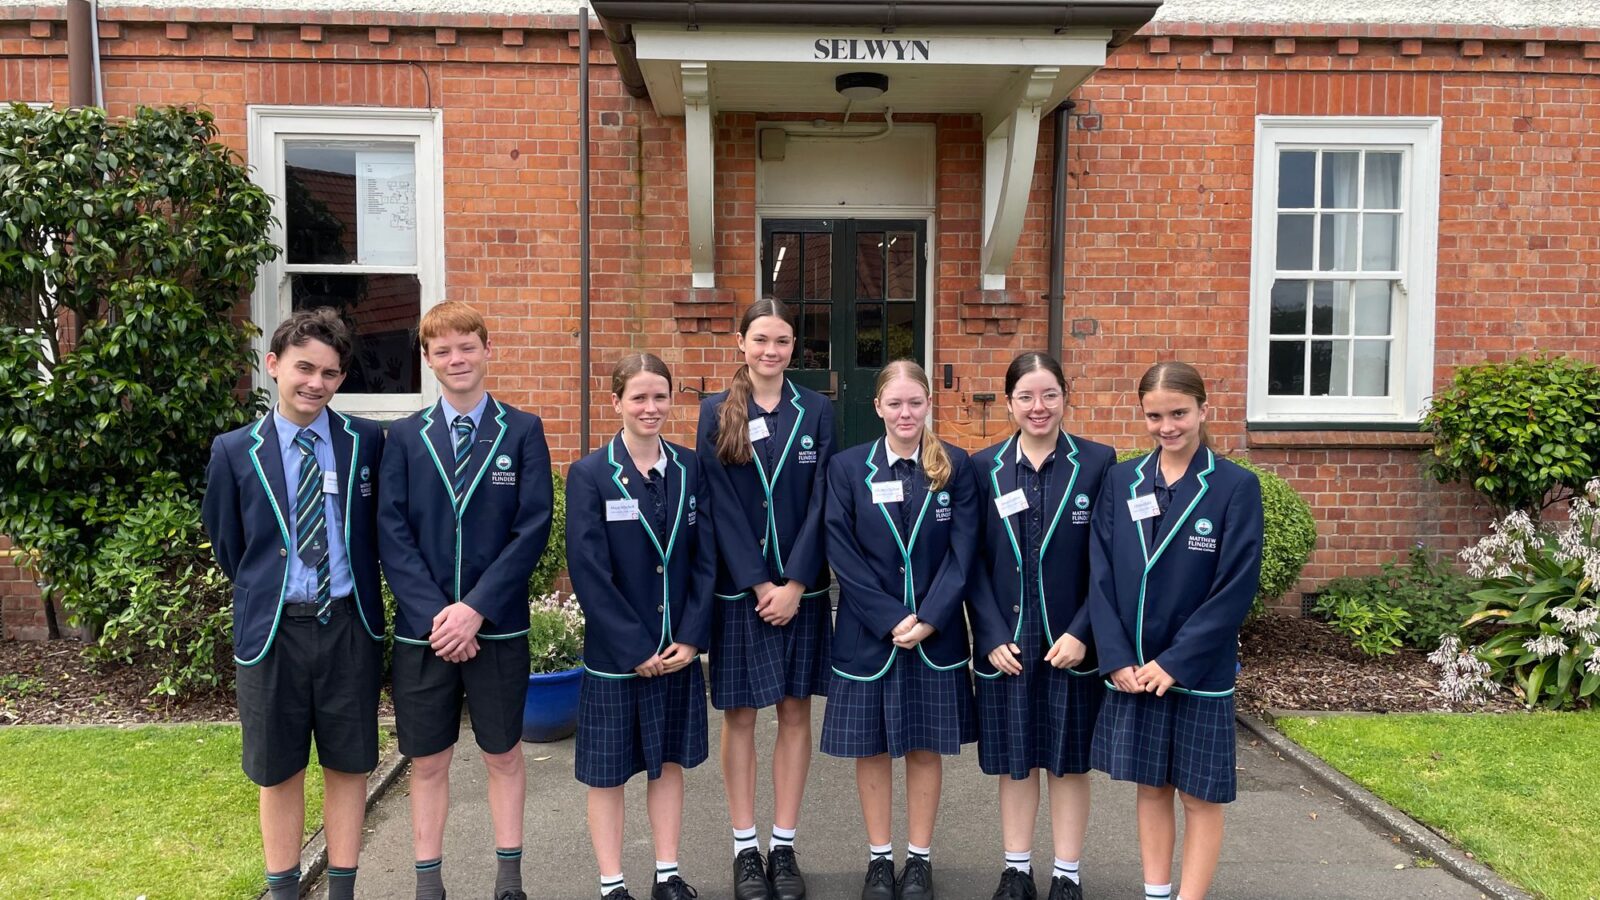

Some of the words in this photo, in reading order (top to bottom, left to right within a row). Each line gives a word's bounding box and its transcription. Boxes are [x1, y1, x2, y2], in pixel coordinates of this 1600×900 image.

[814, 39, 930, 60] SELWYN
[1189, 535, 1216, 543] MATTHEW
[1188, 541, 1216, 549] FLINDERS
